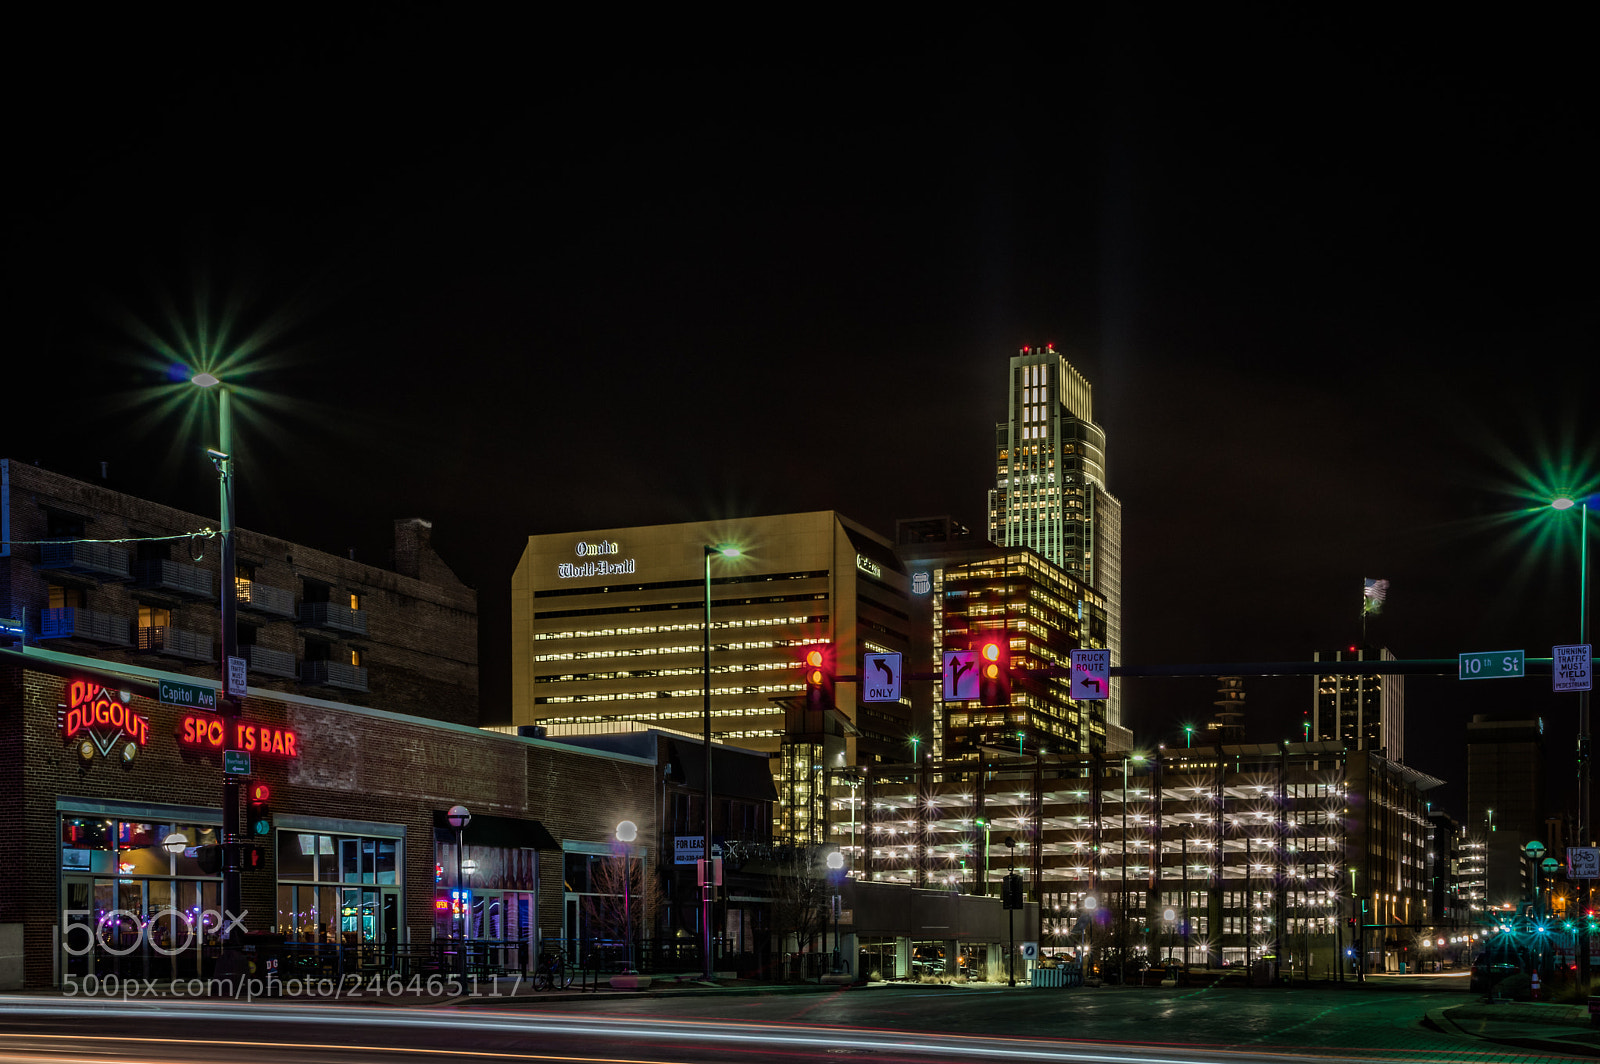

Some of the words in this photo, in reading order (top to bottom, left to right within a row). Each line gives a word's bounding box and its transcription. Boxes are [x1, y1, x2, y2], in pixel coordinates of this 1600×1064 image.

[575, 540, 618, 557] Omaha
[558, 558, 635, 578] World-Herald
[1558, 647, 1587, 656] TURNING
[1076, 653, 1105, 662] TRUCK
[1558, 655, 1587, 663] TRAFFIC
[1076, 663, 1104, 672] ROUTE
[1502, 656, 1519, 672] St
[1561, 662, 1583, 671] MUST
[1559, 670, 1586, 679] YIELD
[161, 684, 193, 703] Capitol
[197, 689, 214, 706] Ave
[869, 688, 893, 698] ONLY
[67, 700, 149, 746] DUGOUT
[183, 717, 256, 751] SPOTS
[260, 727, 297, 757] BAR
[676, 839, 689, 849] FOR
[689, 839, 705, 849] LEAS
